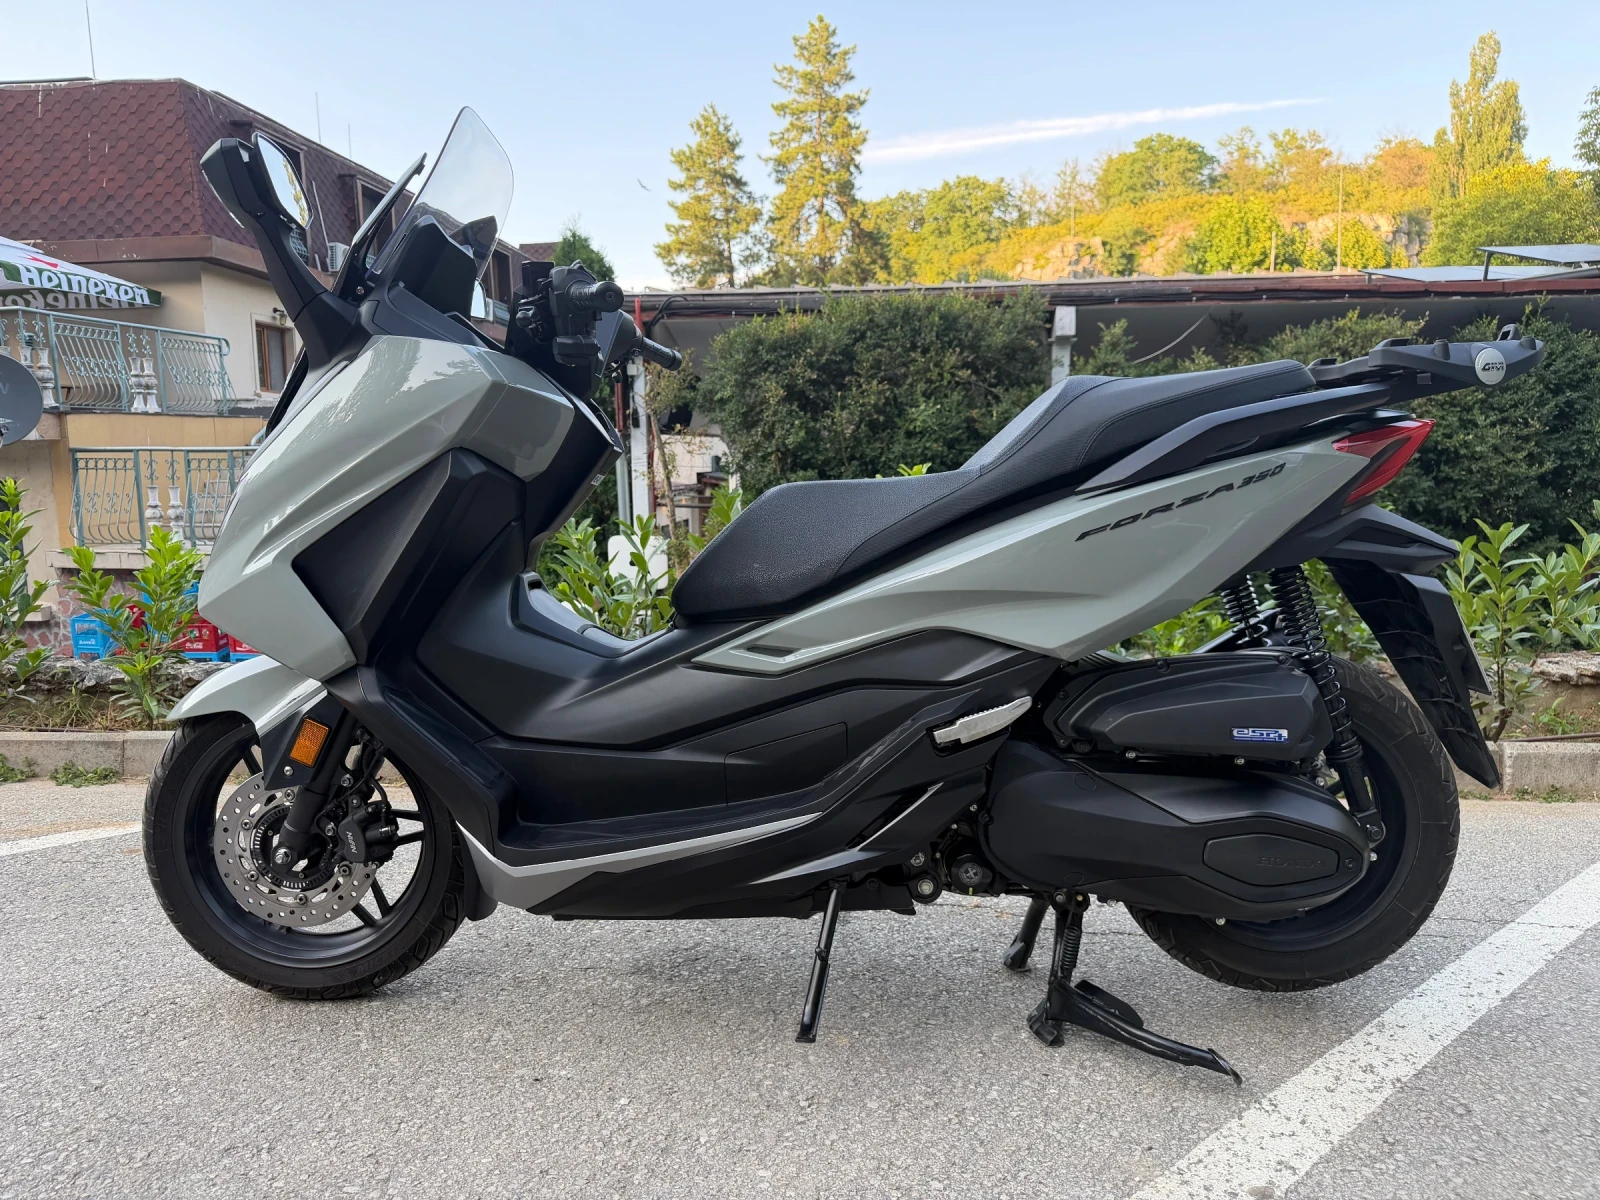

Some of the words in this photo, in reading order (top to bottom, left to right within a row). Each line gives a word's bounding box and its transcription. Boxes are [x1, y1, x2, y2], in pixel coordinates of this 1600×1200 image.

[17, 263, 150, 305] Heineken
[1481, 361, 1505, 371] GIVI
[1075, 483, 1234, 542] FORZA
[1237, 462, 1286, 489] 350
